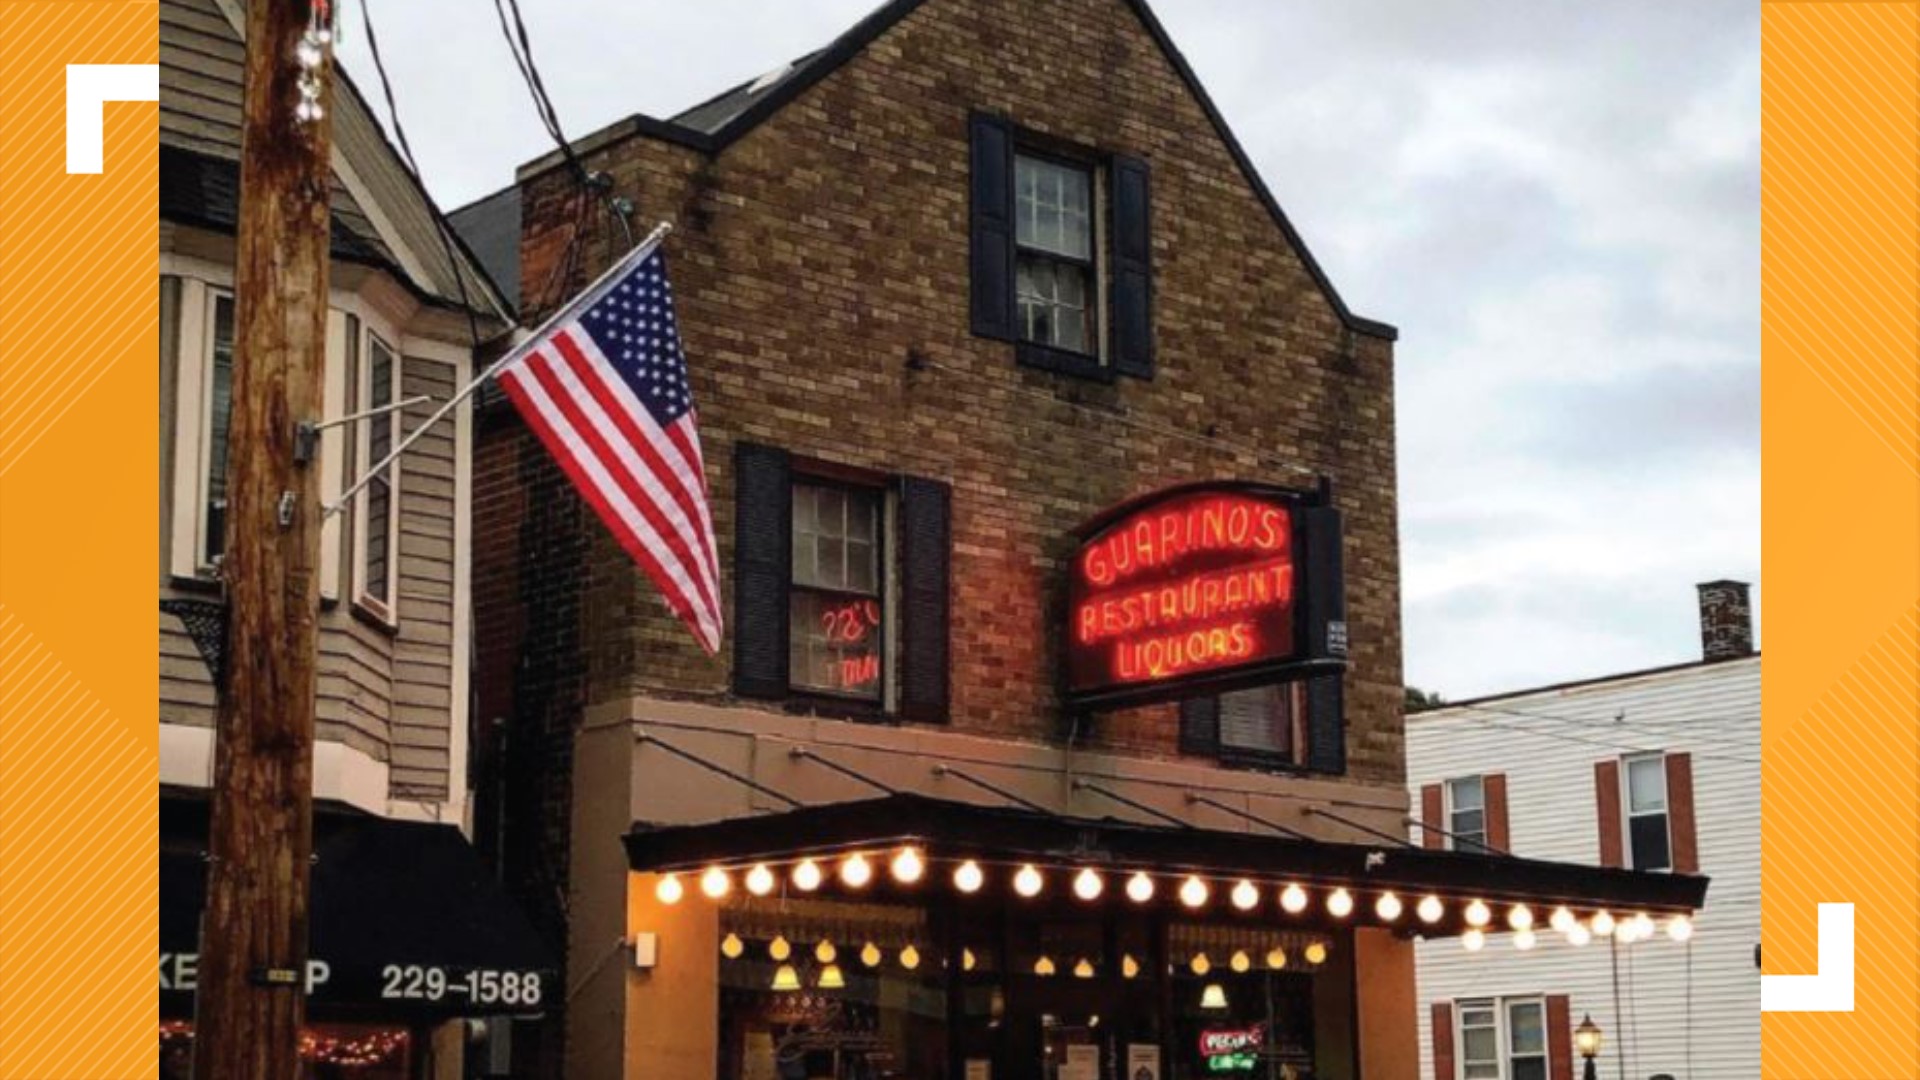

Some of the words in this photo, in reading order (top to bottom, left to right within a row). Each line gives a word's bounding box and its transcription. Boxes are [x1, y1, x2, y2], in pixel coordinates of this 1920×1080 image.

[1085, 501, 1281, 583] GUARINO'S
[1079, 563, 1292, 641] RESTAURANT
[1117, 622, 1247, 678] LIQUORS
[382, 964, 541, 1005] 229-1588
